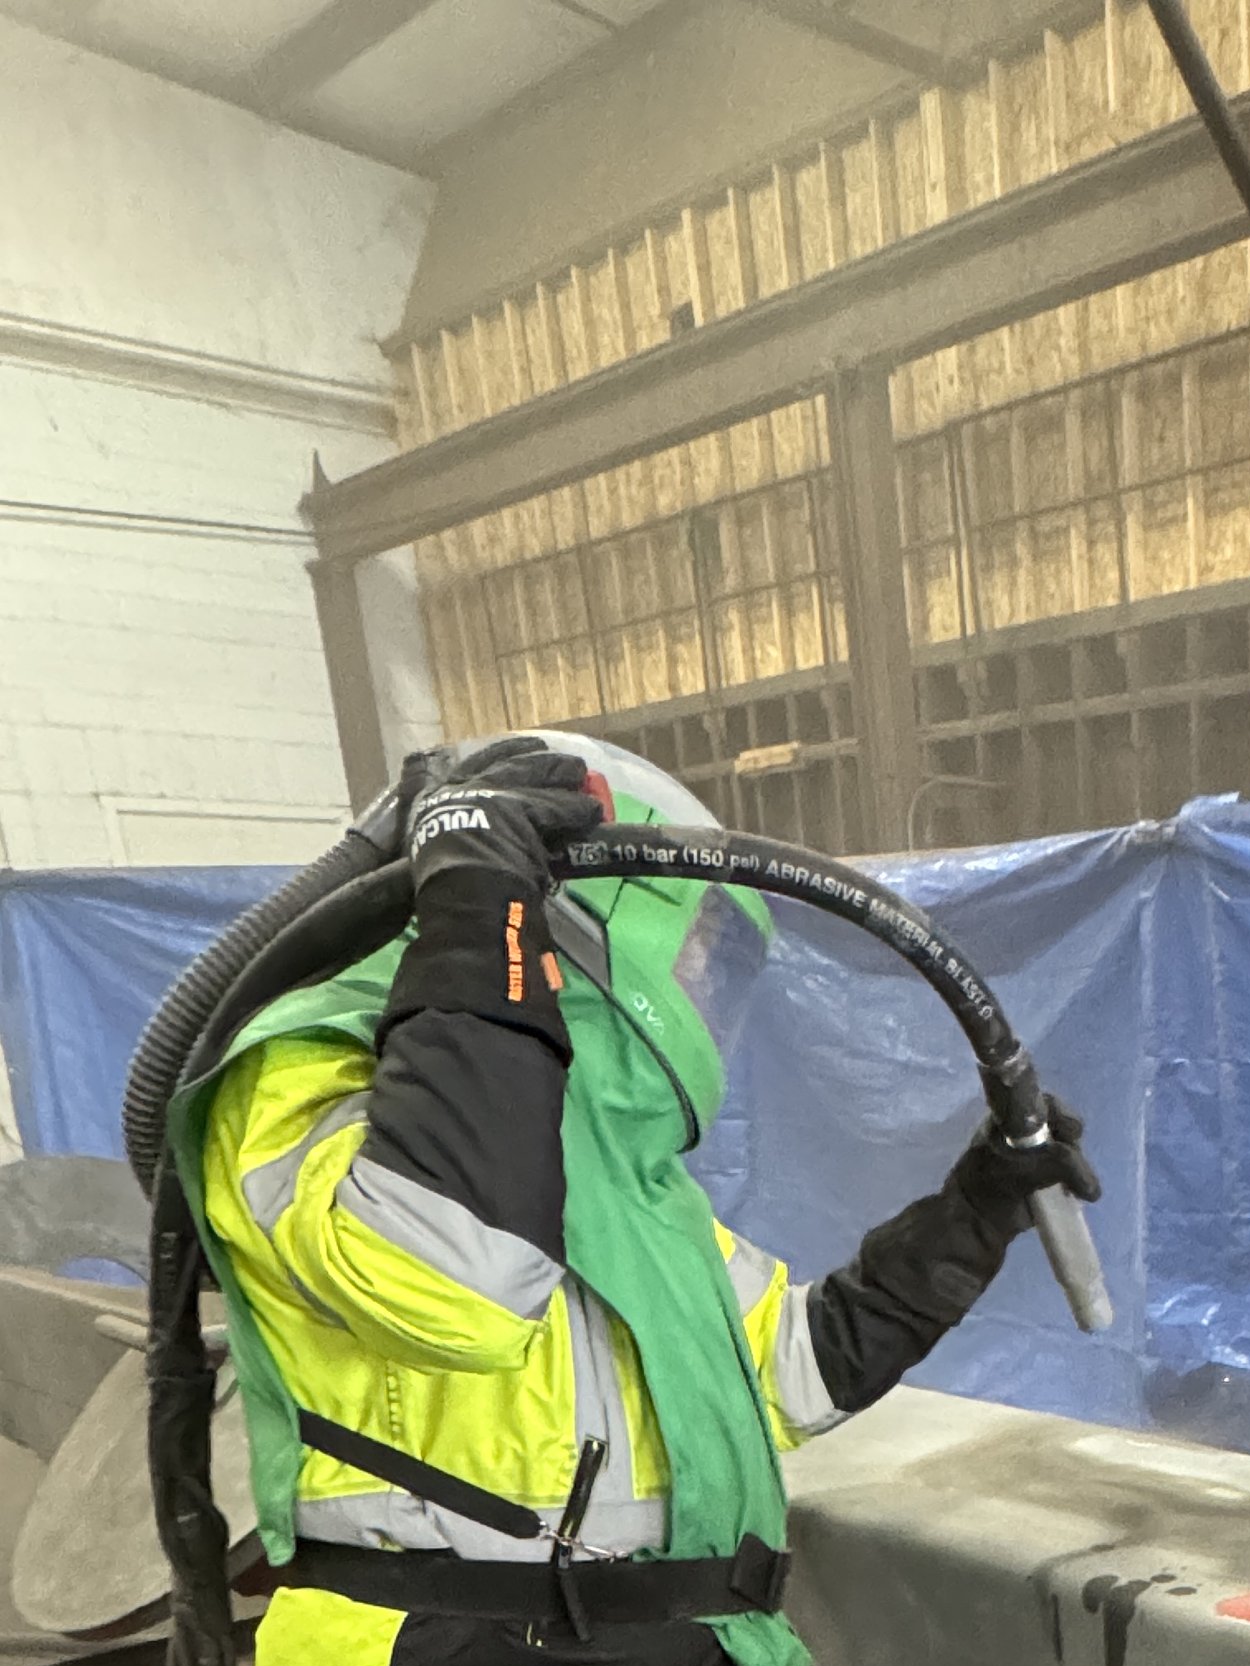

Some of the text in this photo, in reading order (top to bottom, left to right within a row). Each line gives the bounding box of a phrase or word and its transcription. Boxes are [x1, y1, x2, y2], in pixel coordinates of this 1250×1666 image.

[613, 843, 637, 861] 10
[642, 844, 677, 864] bar
[683, 845, 724, 867] (150
[765, 859, 868, 908] ABRASIVE
